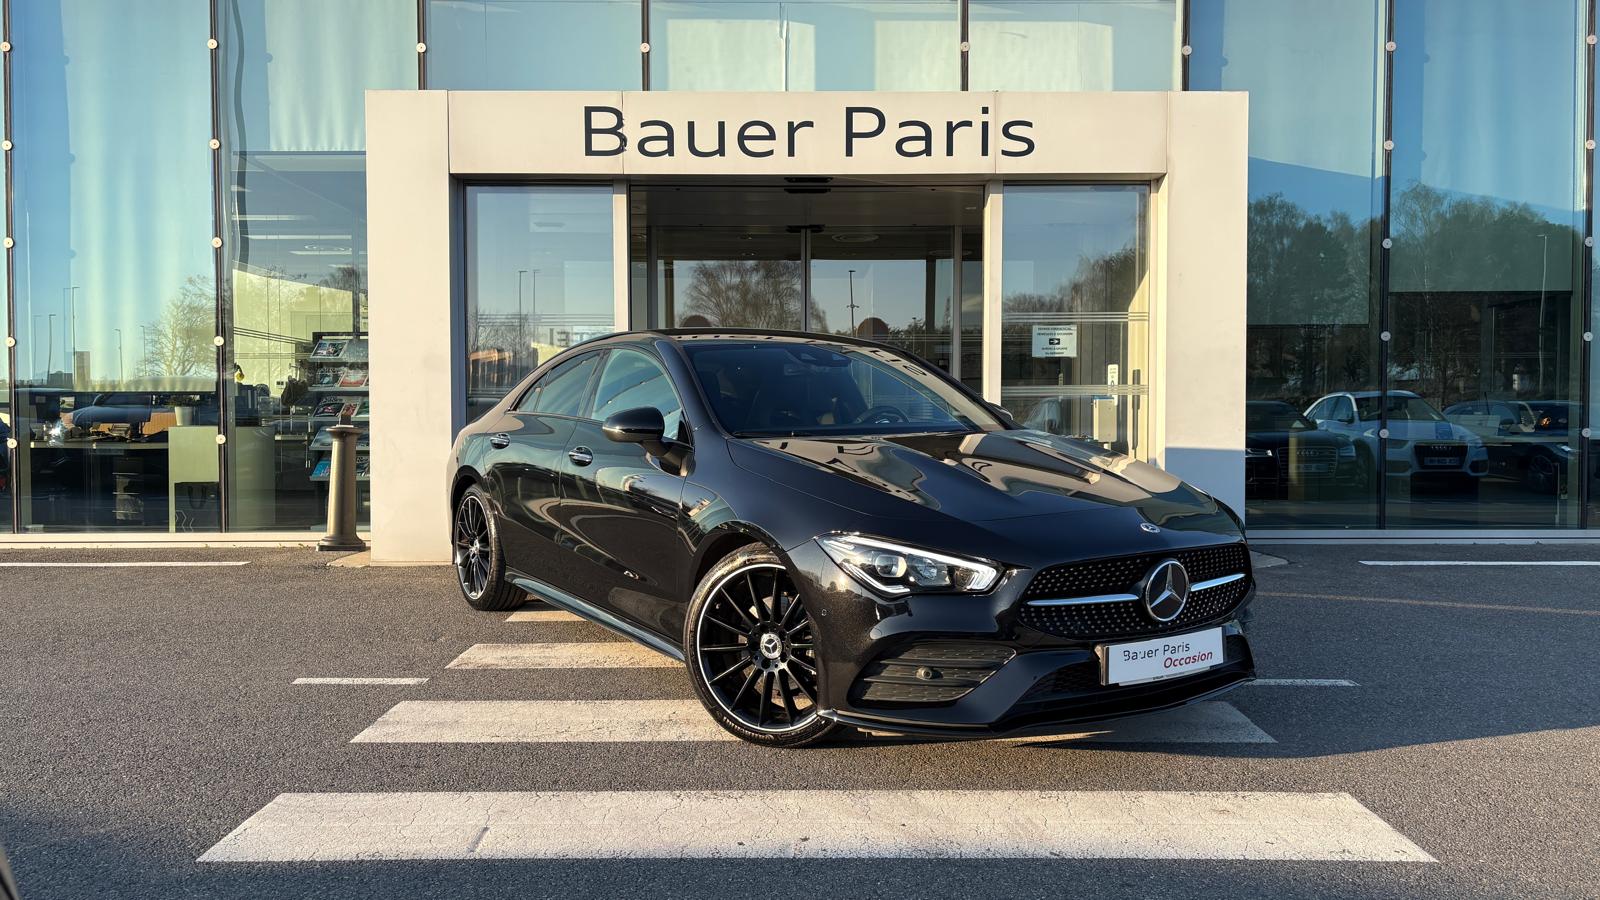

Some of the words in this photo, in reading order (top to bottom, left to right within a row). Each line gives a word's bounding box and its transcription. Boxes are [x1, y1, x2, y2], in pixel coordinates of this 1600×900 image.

[583, 105, 815, 158] Bauer
[845, 105, 1036, 158] Paris
[1123, 648, 1159, 661] Bauer
[1163, 642, 1190, 655] Paris
[1164, 651, 1213, 668] Occasion
